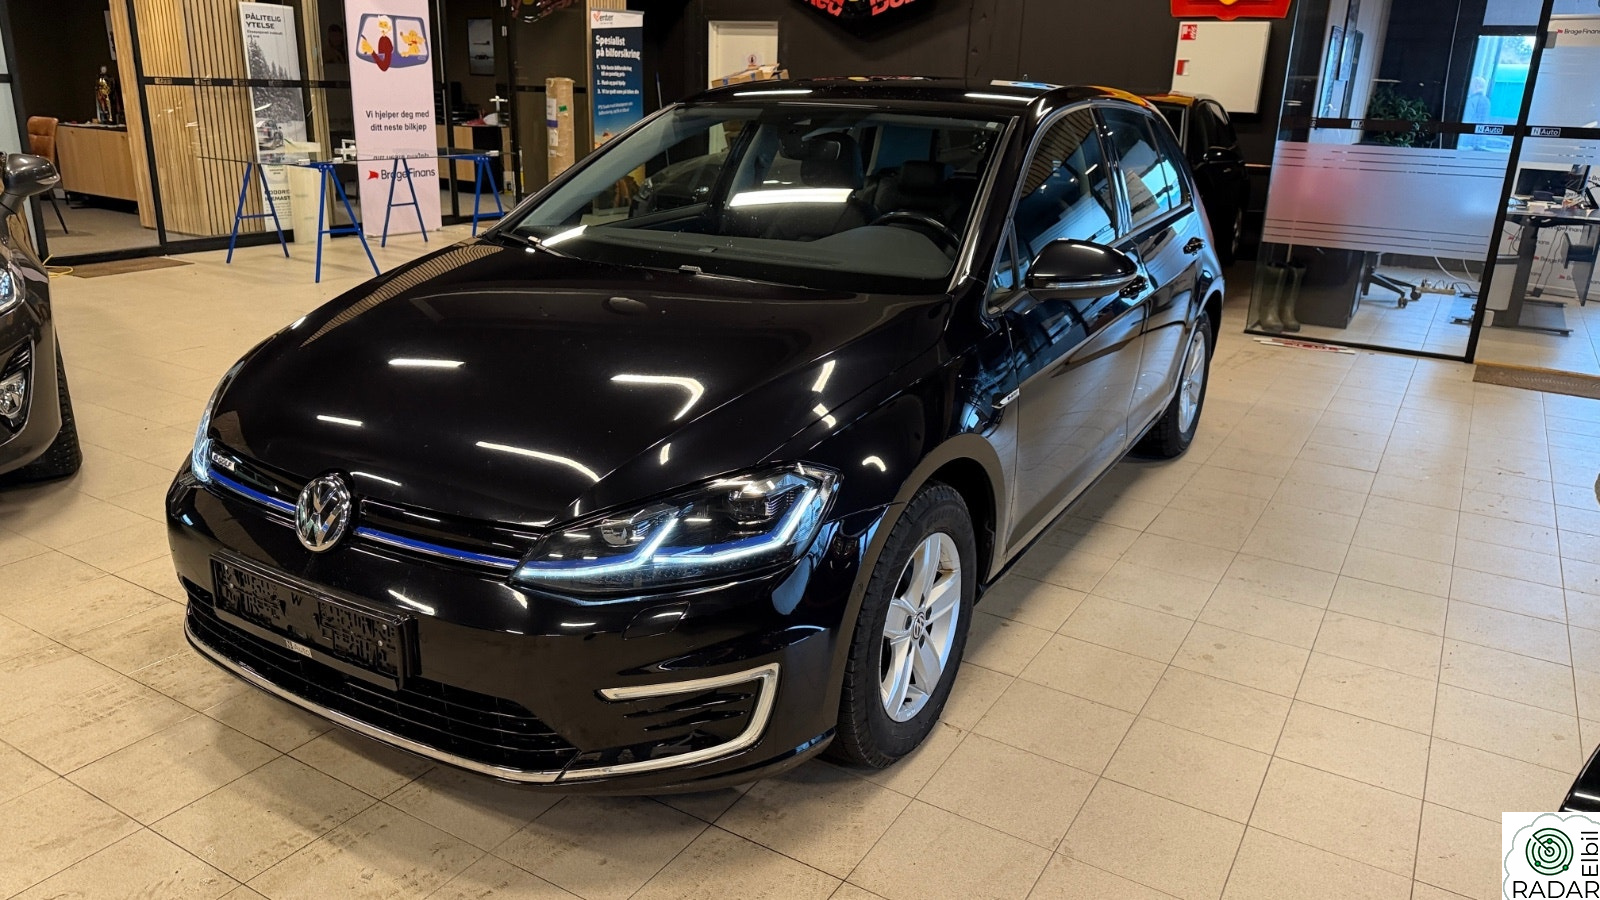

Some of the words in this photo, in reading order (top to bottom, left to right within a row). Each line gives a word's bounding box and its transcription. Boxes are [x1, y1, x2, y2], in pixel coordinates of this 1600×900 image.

[245, 12, 281, 22] PÅLITELIG
[246, 21, 275, 29] YTELSE
[595, 35, 626, 46] Spesialist
[595, 47, 605, 59] på
[605, 48, 641, 60] bilforsikring
[366, 110, 373, 118] Vi
[375, 110, 399, 120] hjelper
[401, 110, 414, 119] deg
[415, 110, 430, 118] med
[405, 123, 427, 132] bilkjøp
